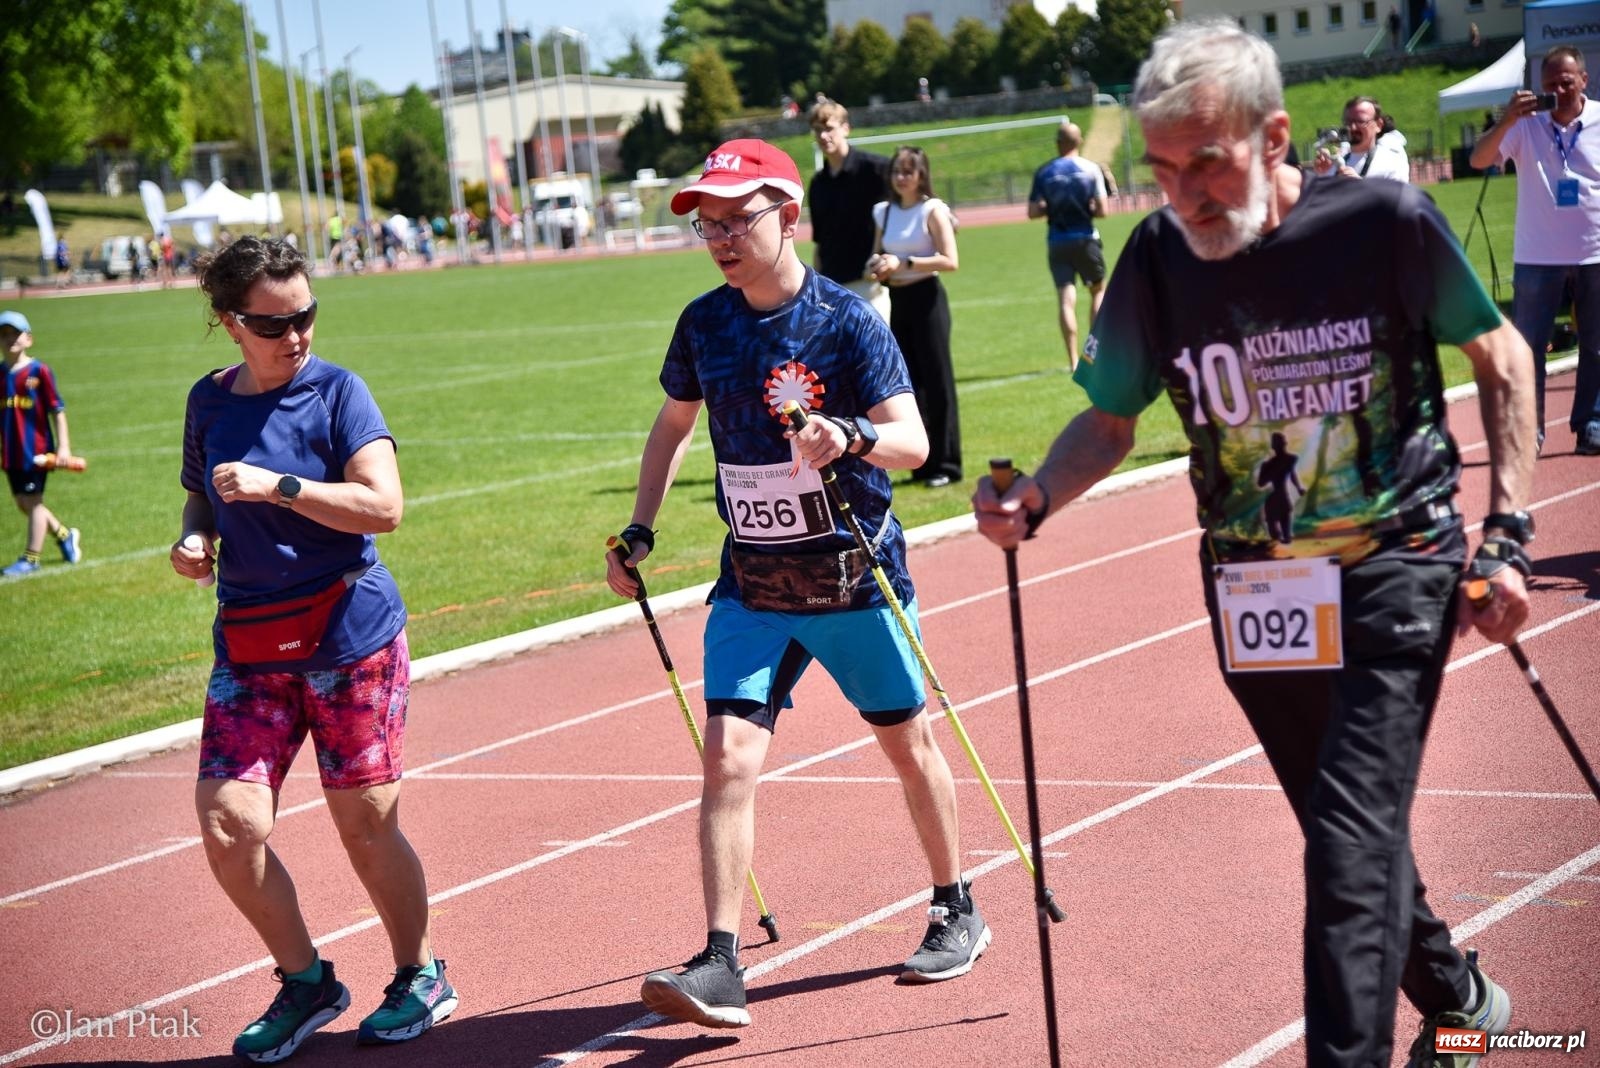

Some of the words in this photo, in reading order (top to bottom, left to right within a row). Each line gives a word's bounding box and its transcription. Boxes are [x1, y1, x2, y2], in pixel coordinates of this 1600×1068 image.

[704, 153, 742, 172] OLSKA
[1243, 317, 1371, 362] KUŹNIAŃSKI
[1172, 343, 1250, 427] 10
[1257, 373, 1374, 421] RAFAMET
[752, 471, 764, 480] BEZ
[736, 498, 797, 530] 256
[278, 640, 301, 651] SPORT
[1238, 608, 1310, 651] 092
